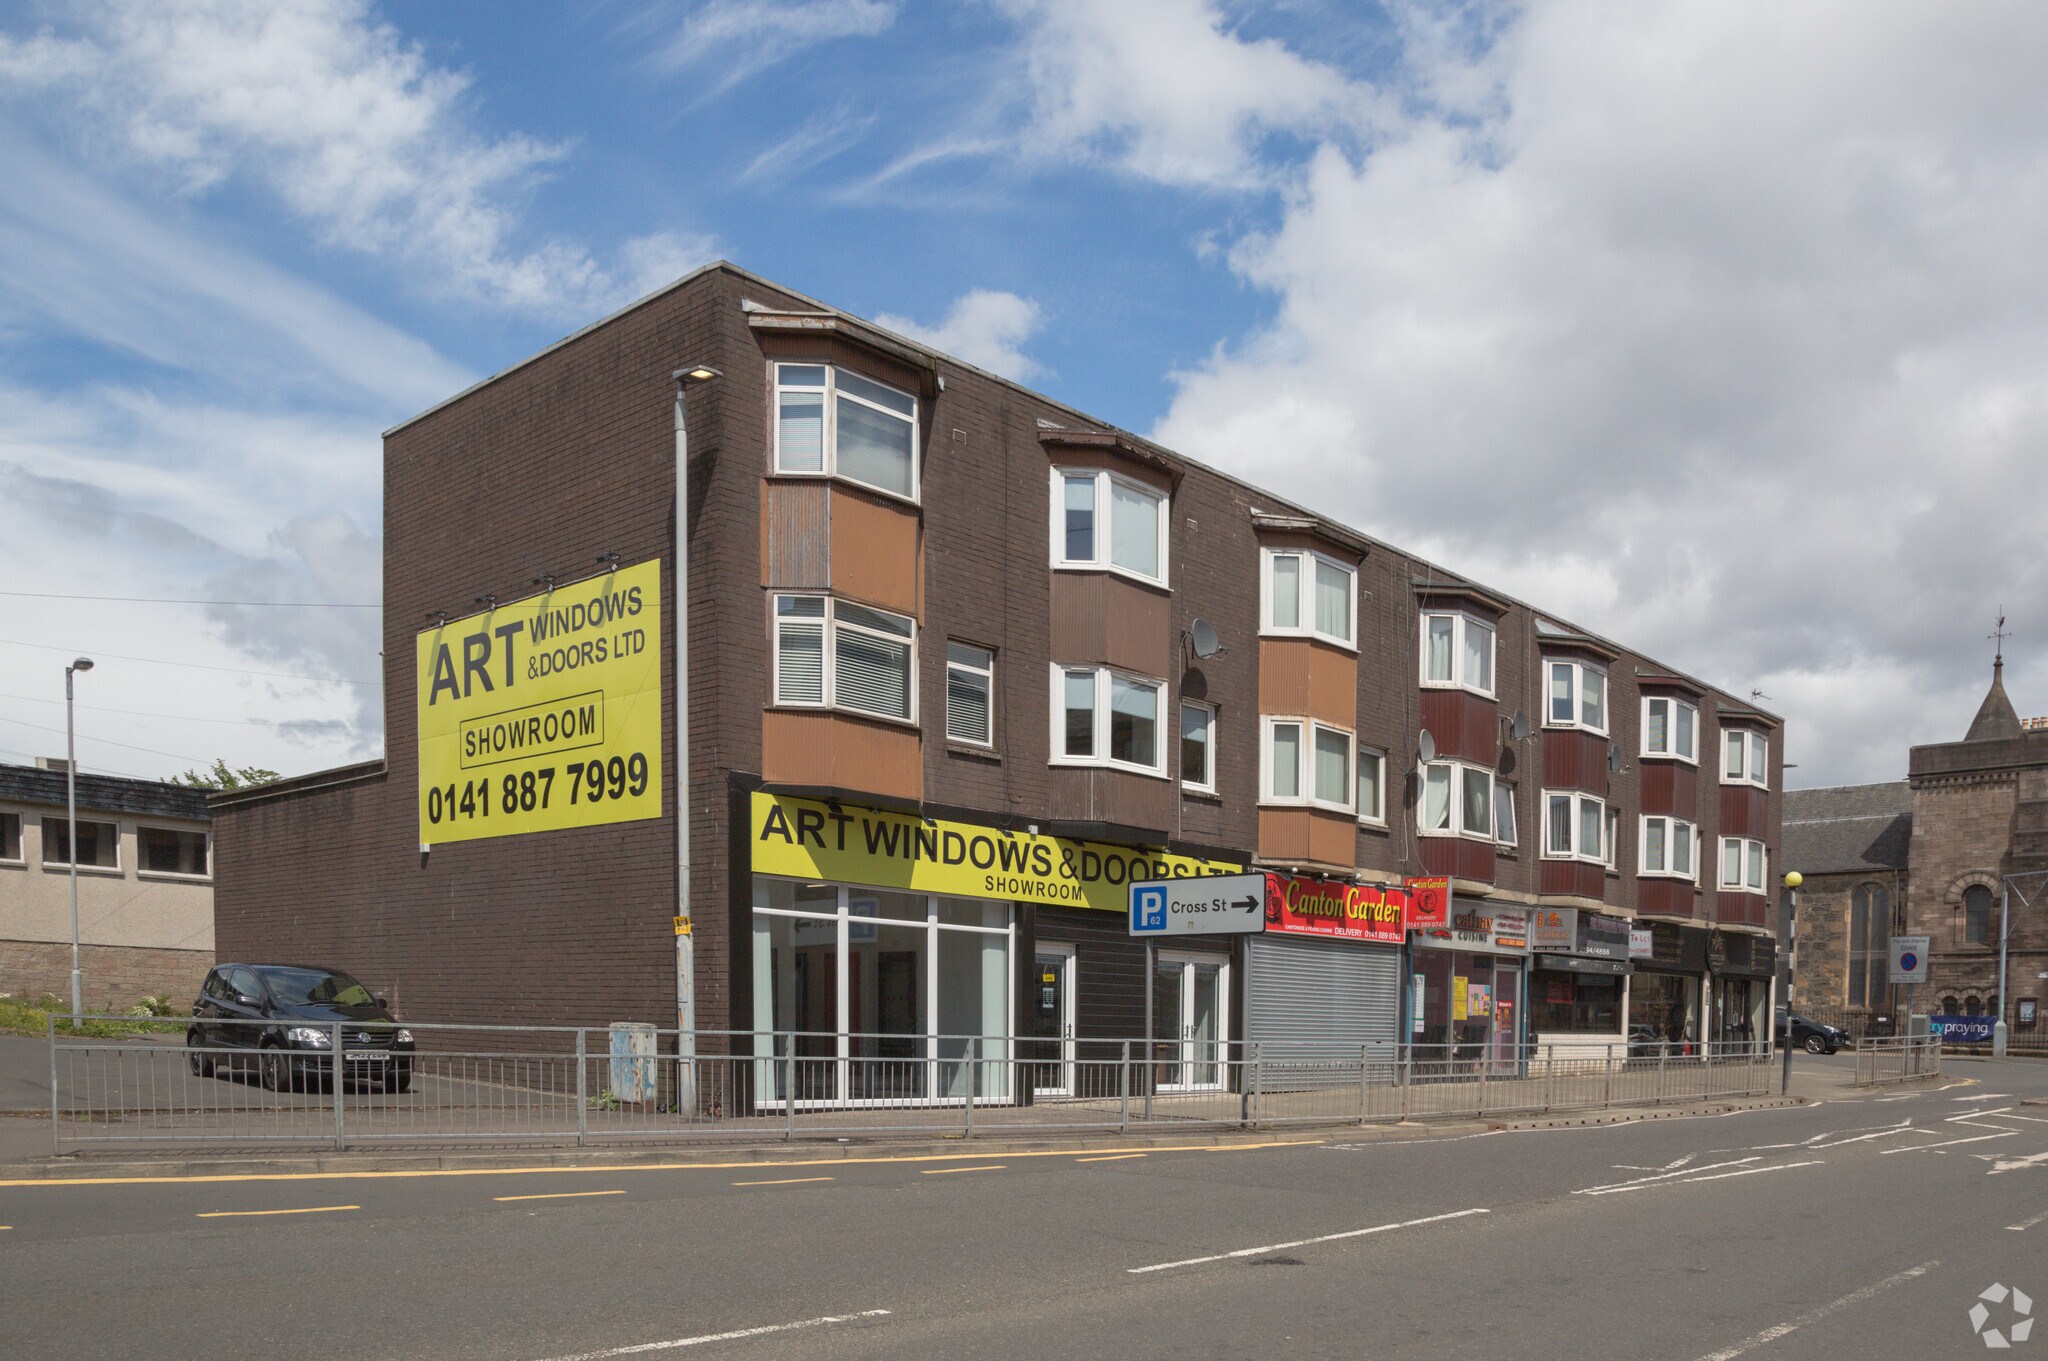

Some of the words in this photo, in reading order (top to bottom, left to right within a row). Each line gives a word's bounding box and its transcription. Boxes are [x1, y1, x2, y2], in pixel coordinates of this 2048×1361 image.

[429, 620, 524, 707] ART
[529, 586, 643, 643] WINDOWS
[527, 637, 608, 680] &DOORS
[614, 628, 646, 660] LTD
[465, 704, 595, 758] SHOWROOM
[428, 777, 489, 825] 0141
[502, 767, 556, 814] 887
[567, 752, 648, 805] 7999
[759, 804, 854, 851] ART
[863, 817, 1051, 876] WINDOWS
[985, 875, 1083, 901] SHOWROOM
[1427, 878, 1448, 889] Garden
[1141, 892, 1162, 927] P
[1171, 901, 1208, 914] Cross
[1212, 899, 1227, 912] St
[1286, 880, 1344, 918] Canton
[1346, 887, 1400, 923] Garden
[1150, 916, 1161, 925] 62
[1334, 927, 1362, 937] DELIVERY
[1378, 931, 1388, 939] 889
[1389, 932, 1402, 940] 0747
[1458, 930, 1488, 943] CUISINE
